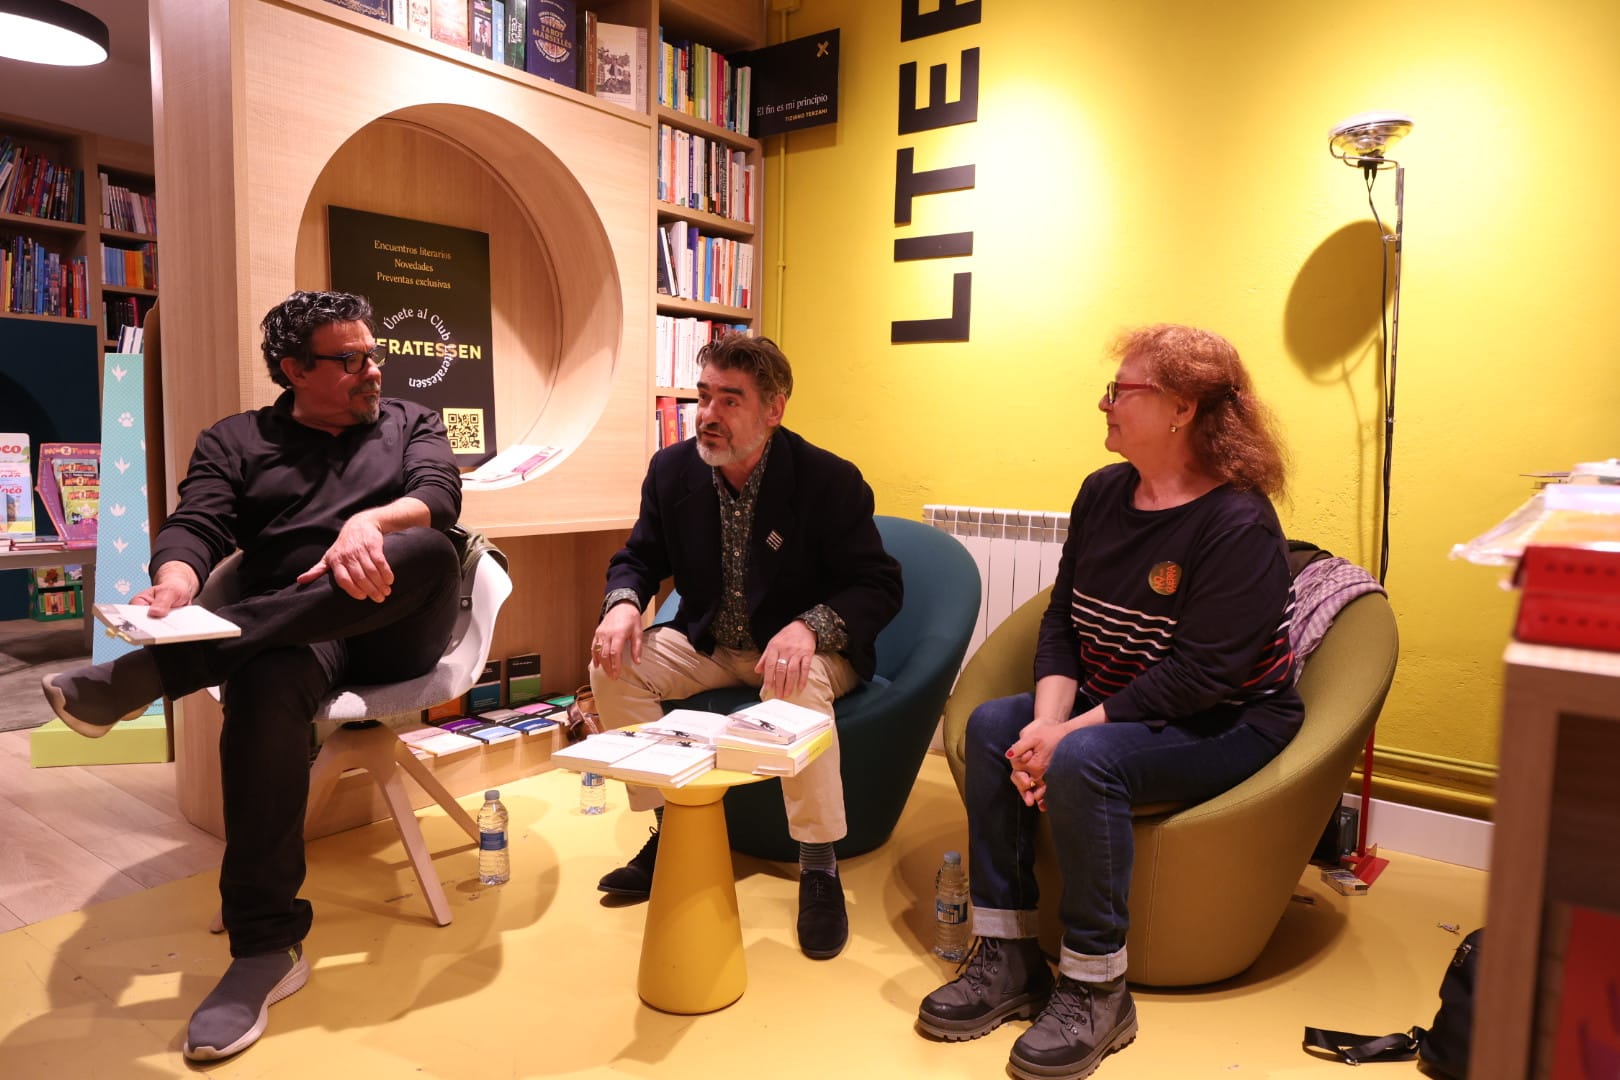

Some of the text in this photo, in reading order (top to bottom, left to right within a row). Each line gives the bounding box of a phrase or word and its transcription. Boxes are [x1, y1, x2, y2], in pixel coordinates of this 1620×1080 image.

[541, 25, 564, 38] TAROT
[756, 94, 828, 117] El fin es mi principio
[374, 239, 452, 260] Encuentros literarios
[394, 258, 434, 272] Novedades
[376, 271, 451, 289] Preventas exclusivas
[383, 307, 454, 388] Únete al Club Literatessen
